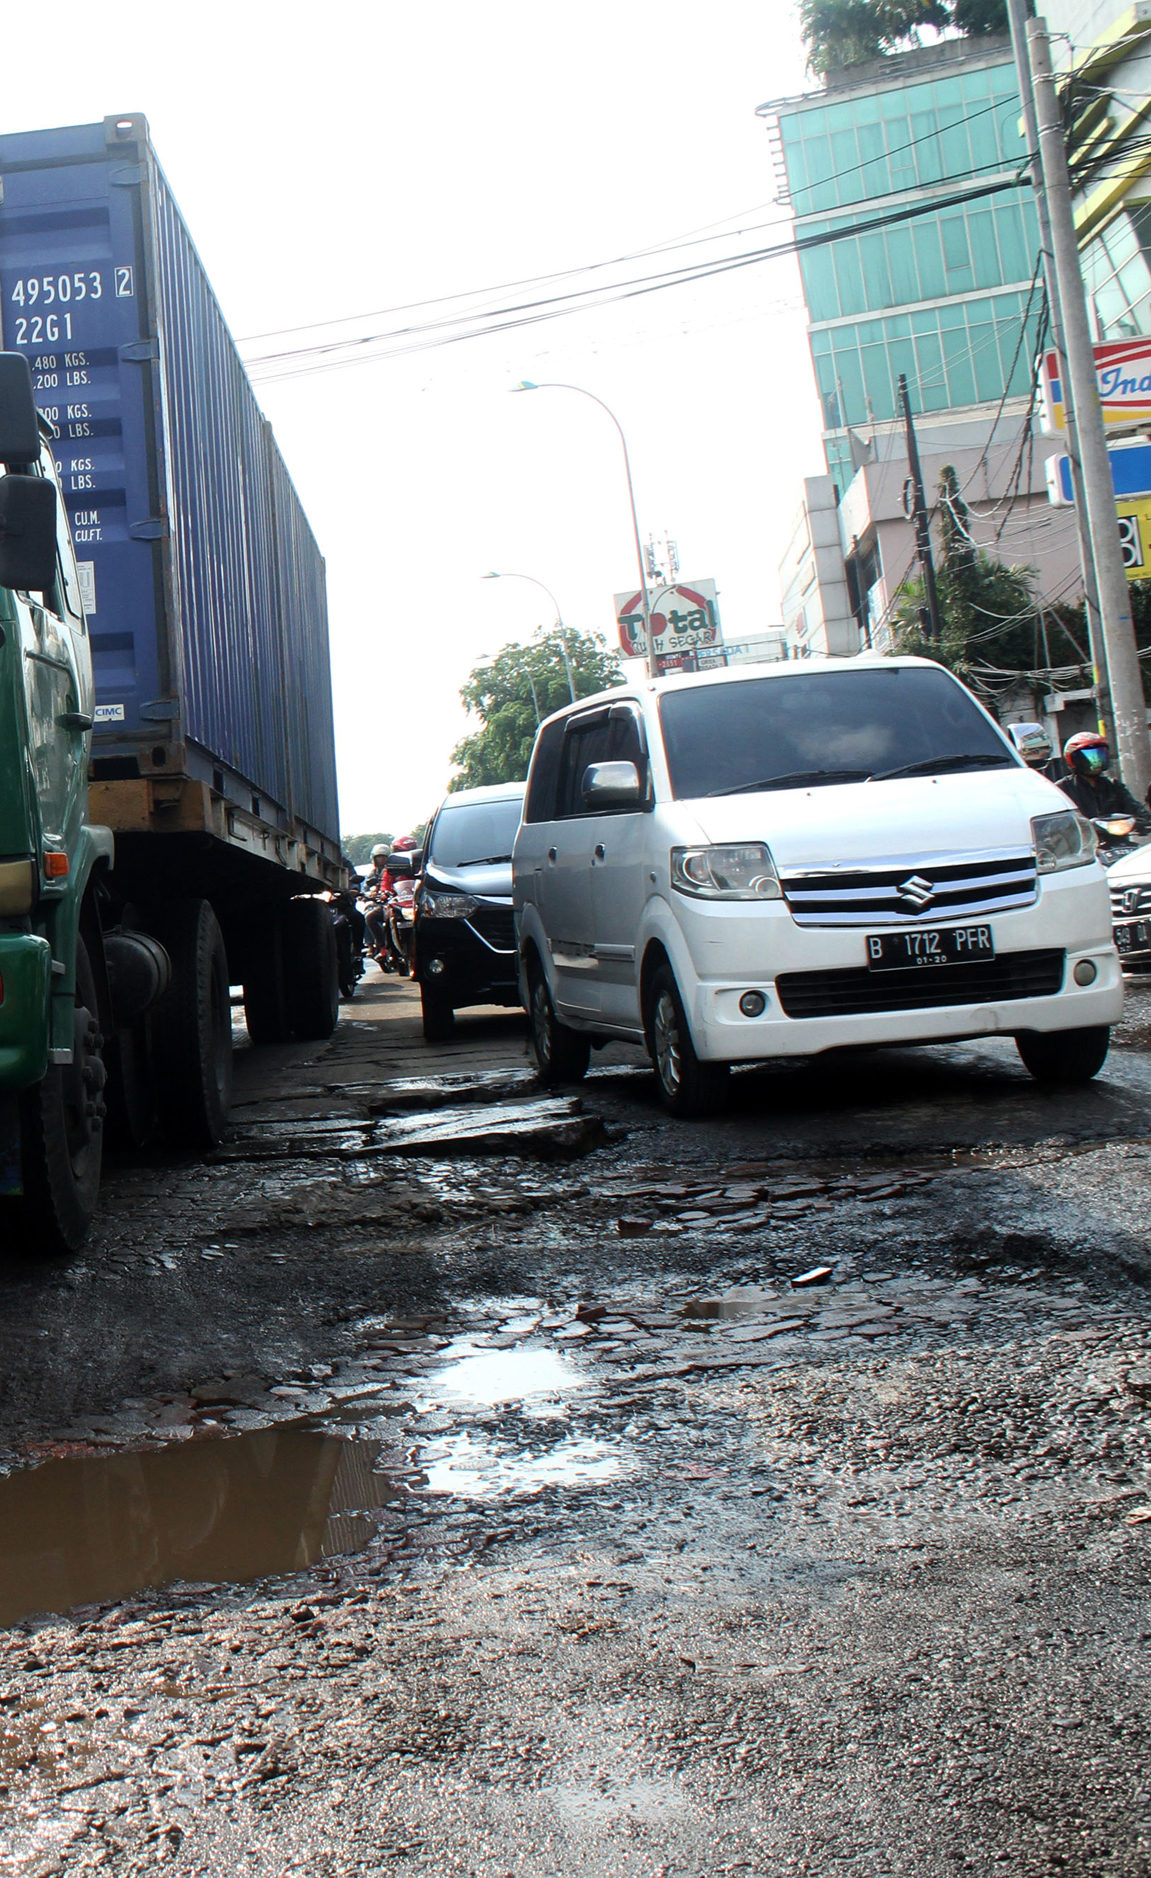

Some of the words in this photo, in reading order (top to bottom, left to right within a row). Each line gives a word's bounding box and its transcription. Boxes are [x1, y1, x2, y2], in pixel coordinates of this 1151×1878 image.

[11, 271, 102, 306] 495053
[116, 268, 132, 296] 2
[15, 312, 72, 345] 22G1
[64, 352, 90, 368] KGS.
[66, 370, 91, 386] LBS.
[67, 403, 92, 419] KGS.
[68, 422, 94, 438] LBS.
[70, 458, 96, 472] KGS.
[71, 474, 96, 490] LBS.
[95, 706, 122, 717] CIMC
[869, 937, 883, 959] B
[905, 932, 941, 956] 1712
[955, 927, 990, 951] PFR
